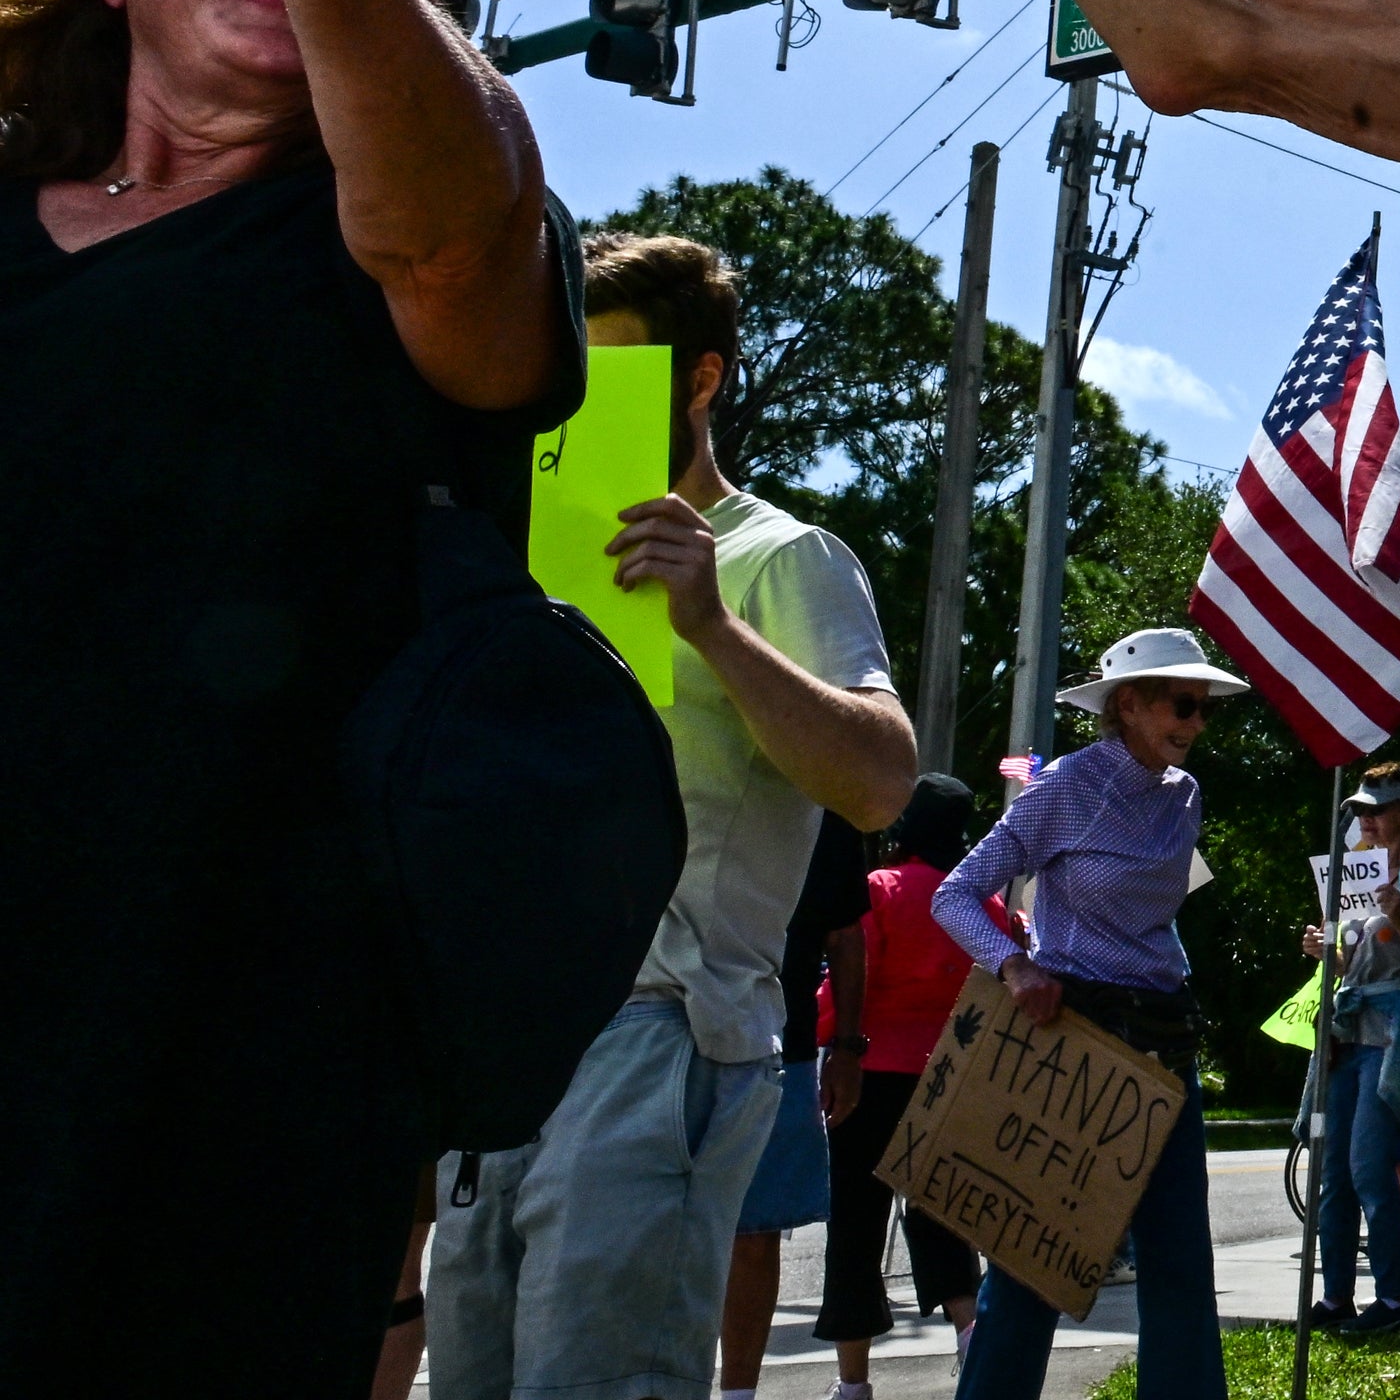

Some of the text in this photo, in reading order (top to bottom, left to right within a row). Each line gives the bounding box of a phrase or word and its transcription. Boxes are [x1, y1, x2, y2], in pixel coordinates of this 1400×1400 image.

[1320, 861, 1380, 884] HNDS
[988, 1006, 1169, 1181] HANDS
[922, 1156, 1102, 1289] EVERYTHING
